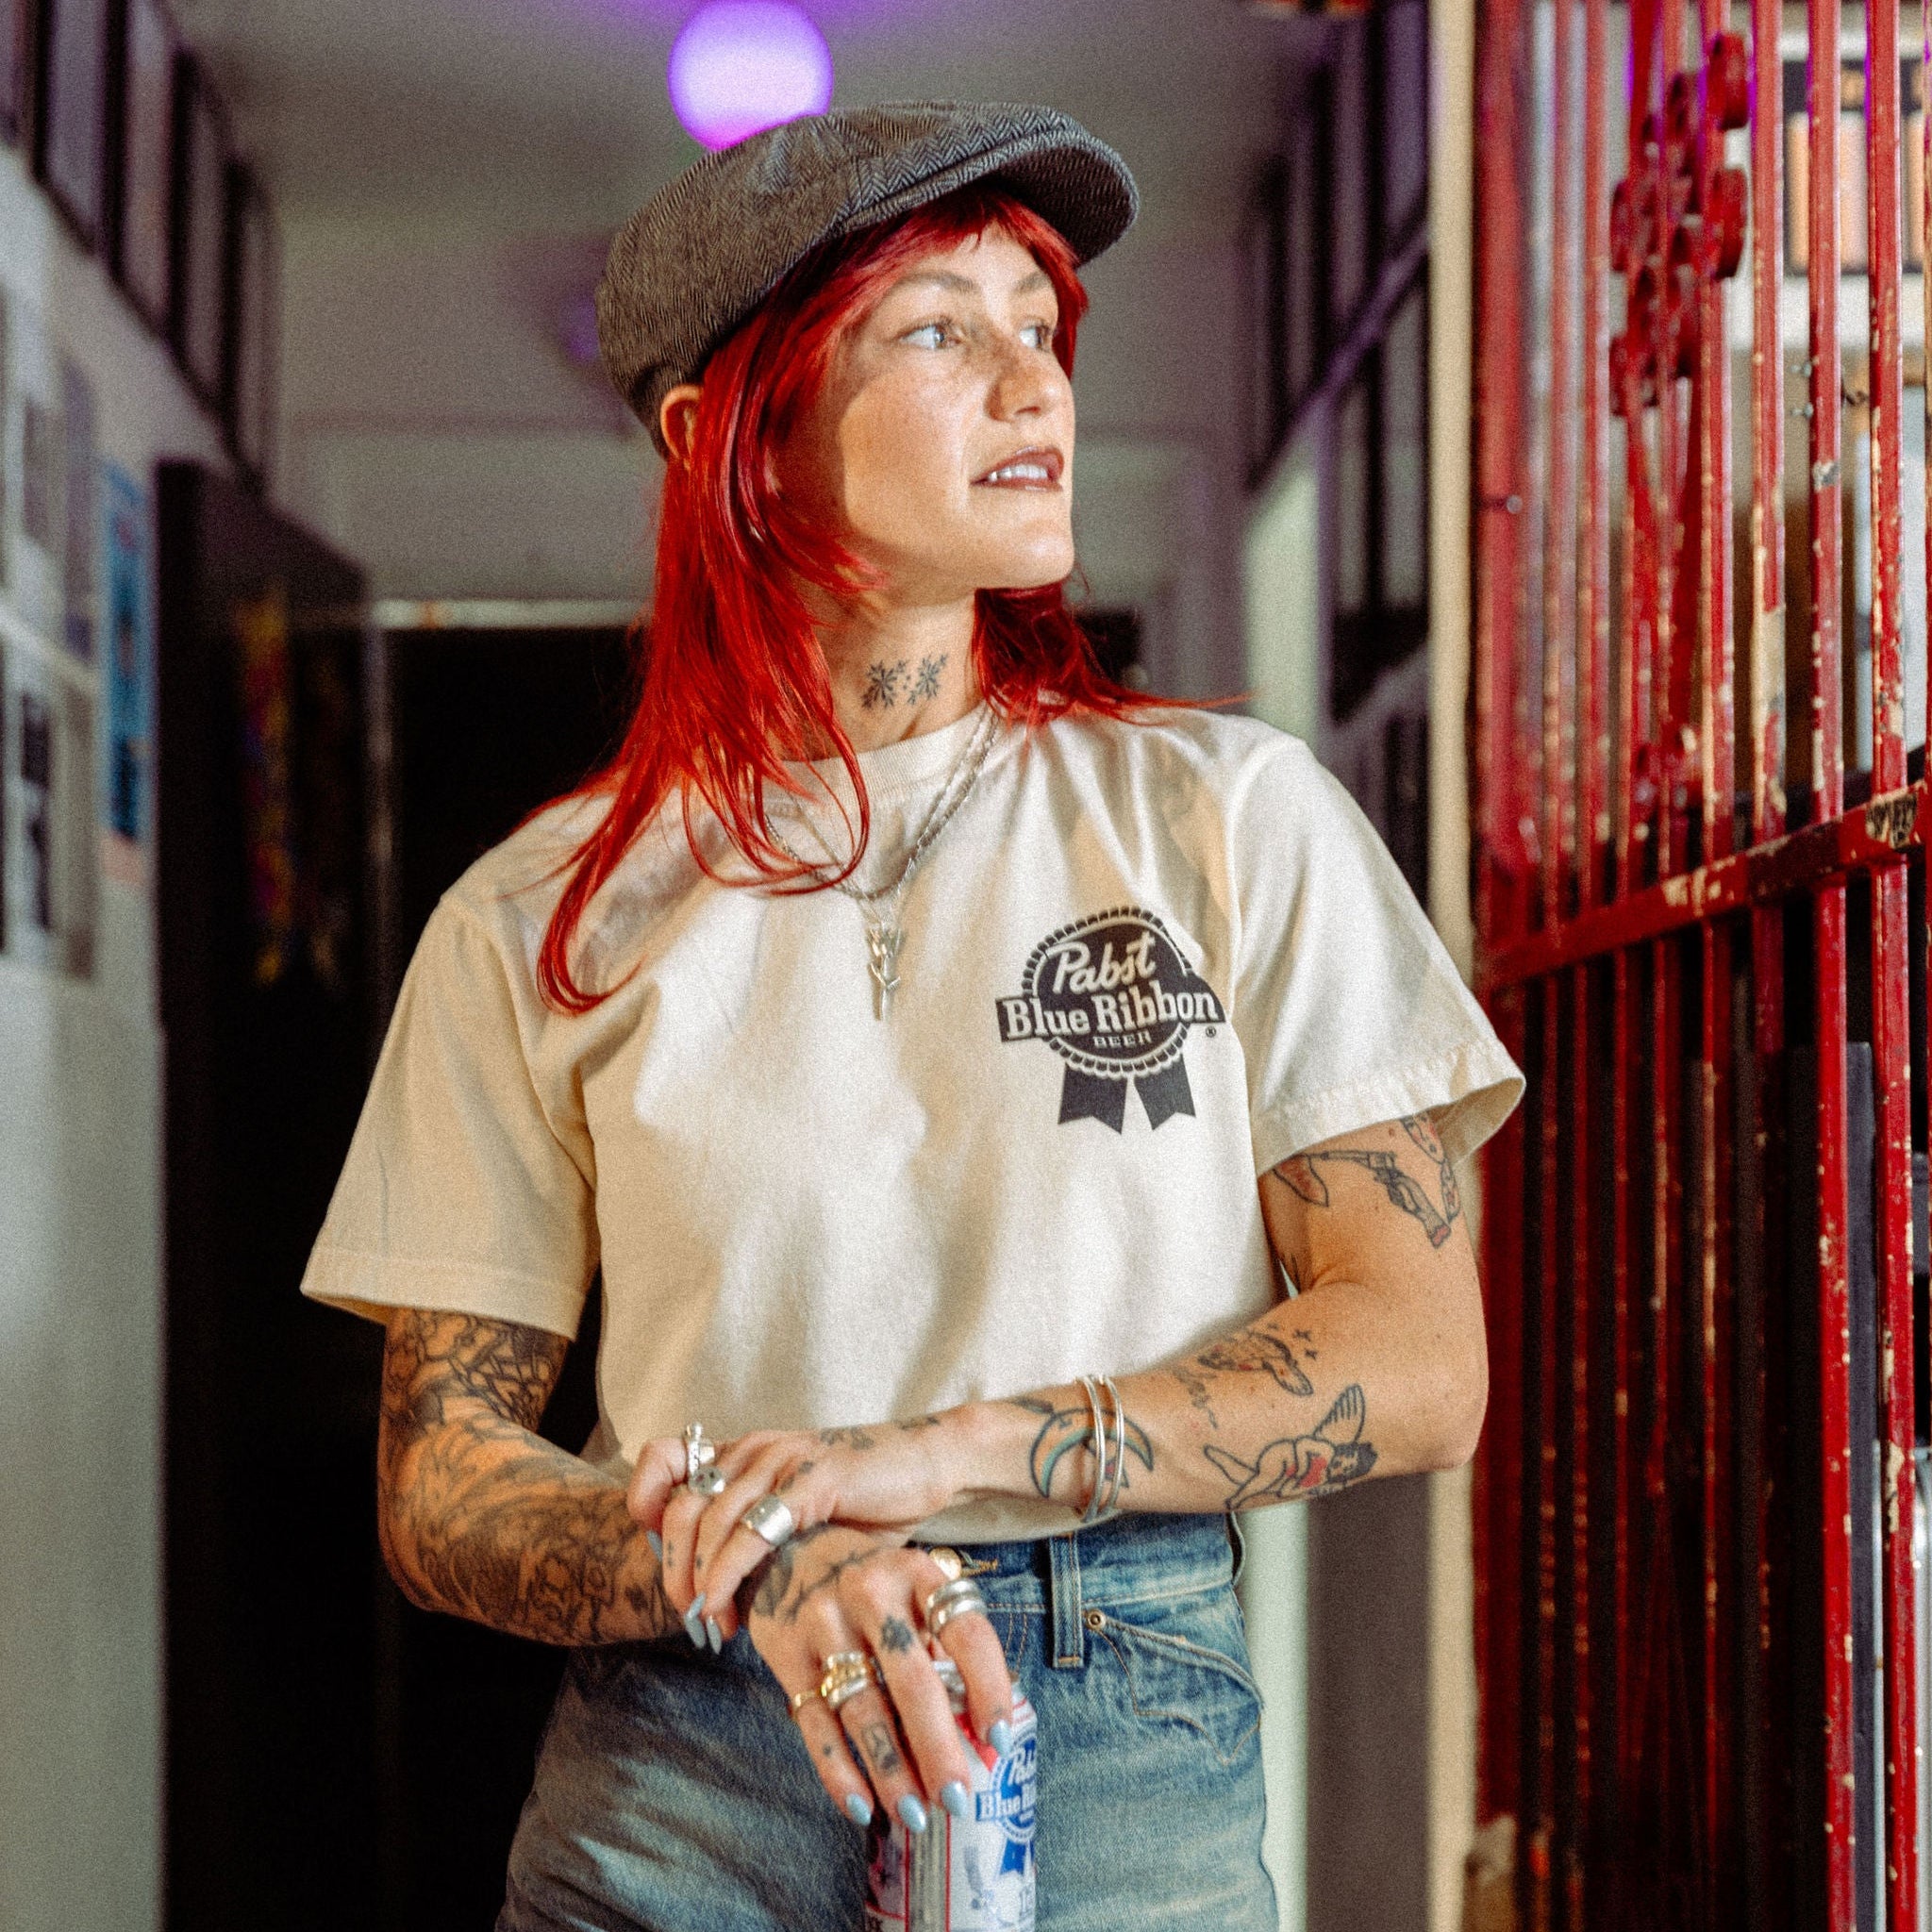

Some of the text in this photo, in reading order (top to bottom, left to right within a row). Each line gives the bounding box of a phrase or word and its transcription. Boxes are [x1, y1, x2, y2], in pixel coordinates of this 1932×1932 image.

[1045, 931, 1157, 994] Pabst
[1003, 980, 1219, 1039] Blue Ribbon
[1093, 1029, 1152, 1049] BEER
